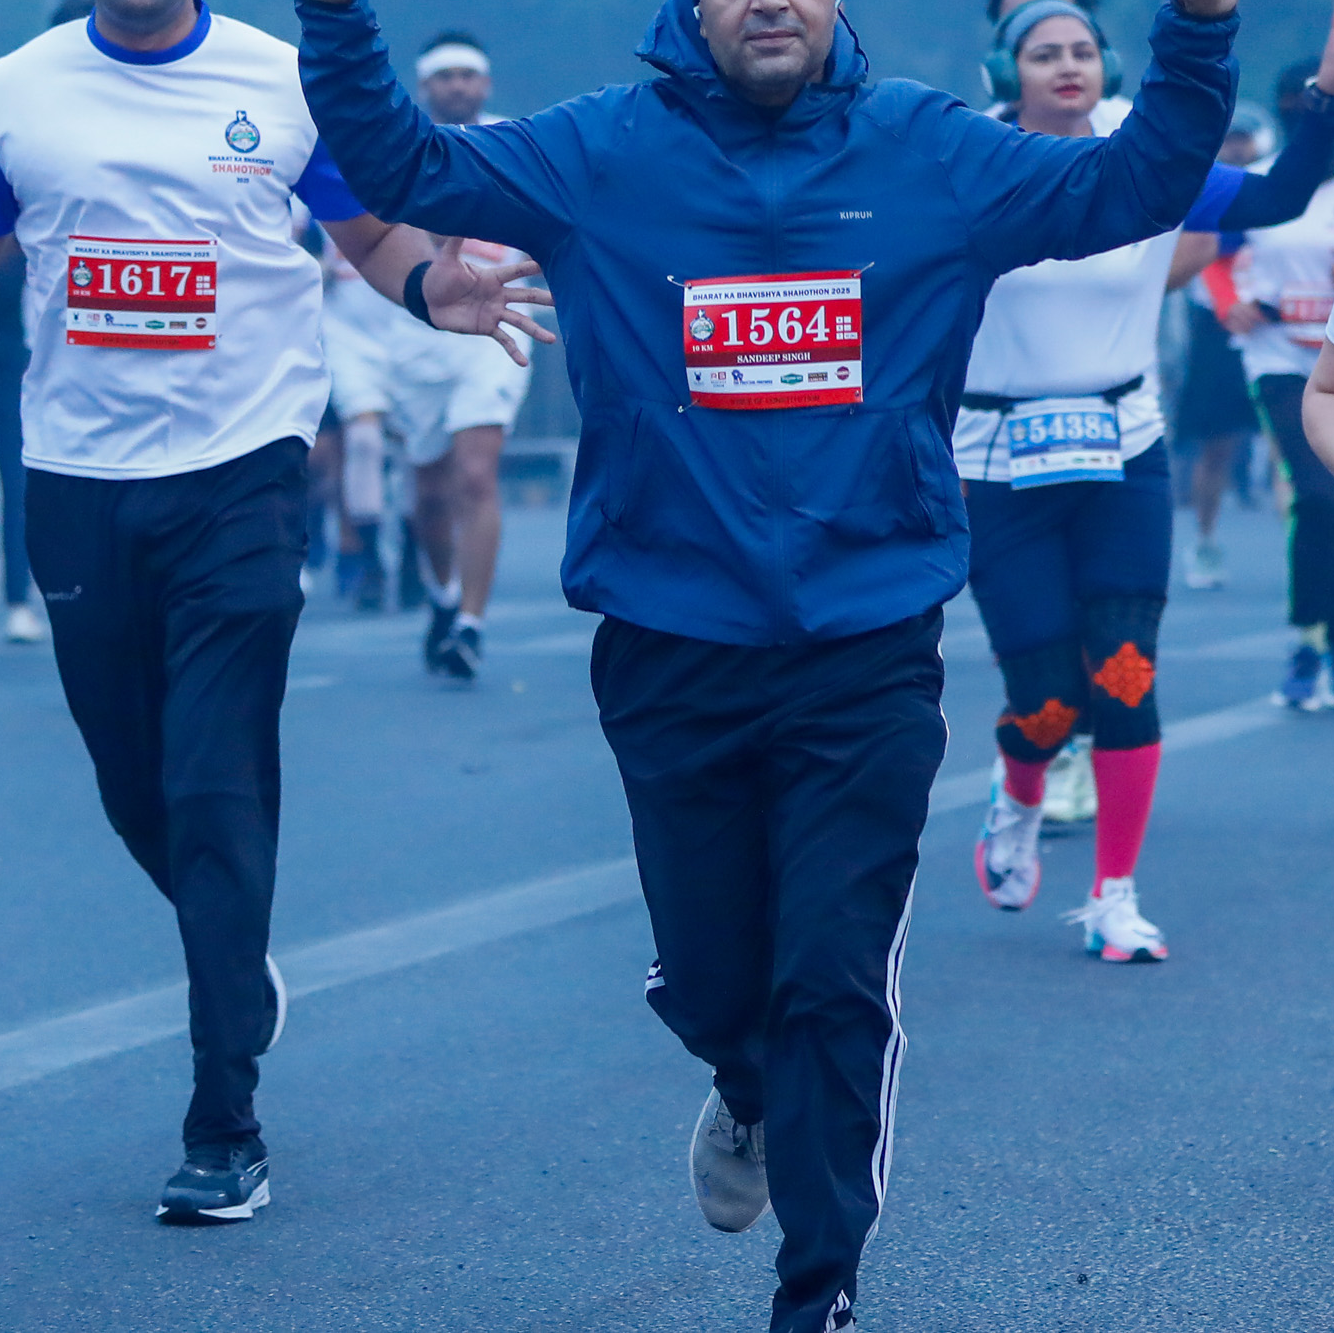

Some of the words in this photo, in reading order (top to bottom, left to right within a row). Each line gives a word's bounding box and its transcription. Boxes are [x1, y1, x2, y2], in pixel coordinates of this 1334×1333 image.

[212, 164, 272, 175] SHAHOTHON
[839, 210, 873, 220] KIPRUN
[75, 246, 100, 254] BHARAT
[151, 250, 192, 258] SHAHOTHON
[98, 263, 192, 297] 1617
[692, 292, 723, 301] BHARAT
[736, 290, 781, 299] BHAVISHYA
[782, 288, 830, 298] SHAHOTHON
[831, 287, 851, 295] 2025
[721, 305, 831, 347] 1564
[692, 344, 700, 352] 10
[701, 344, 714, 352] KM
[736, 353, 781, 364] SANDEEP
[782, 351, 811, 362] SINGH
[1030, 414, 1101, 443] 5438
